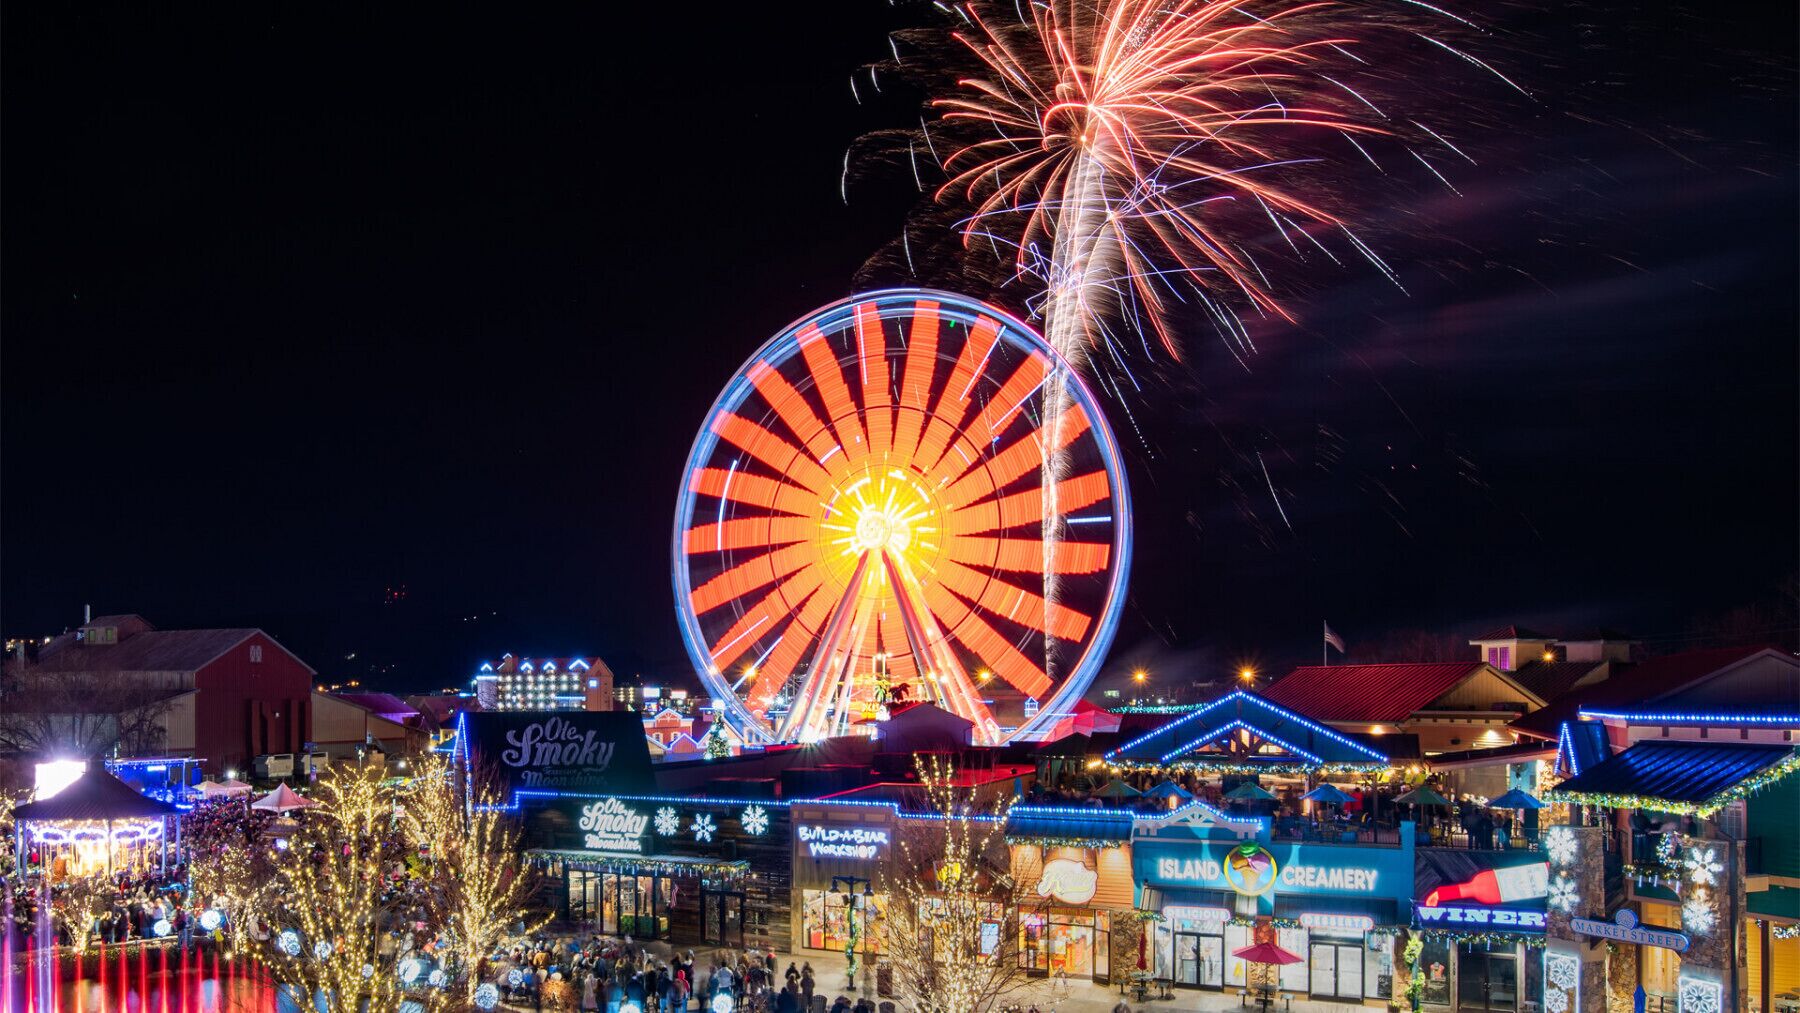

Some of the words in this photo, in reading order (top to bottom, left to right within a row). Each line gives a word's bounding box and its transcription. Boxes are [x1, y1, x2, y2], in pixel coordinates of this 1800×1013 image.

[543, 716, 584, 742] Ole
[501, 723, 616, 773] Smoky
[604, 797, 627, 816] Ole
[579, 801, 649, 839] Smoky
[809, 842, 877, 859] WORKSHOP
[1158, 858, 1220, 881] ISLAND
[1281, 866, 1378, 891] CREAMERY
[1418, 906, 1548, 927] WINER
[1575, 921, 1626, 938] MARKET
[1630, 929, 1681, 947] STREET
